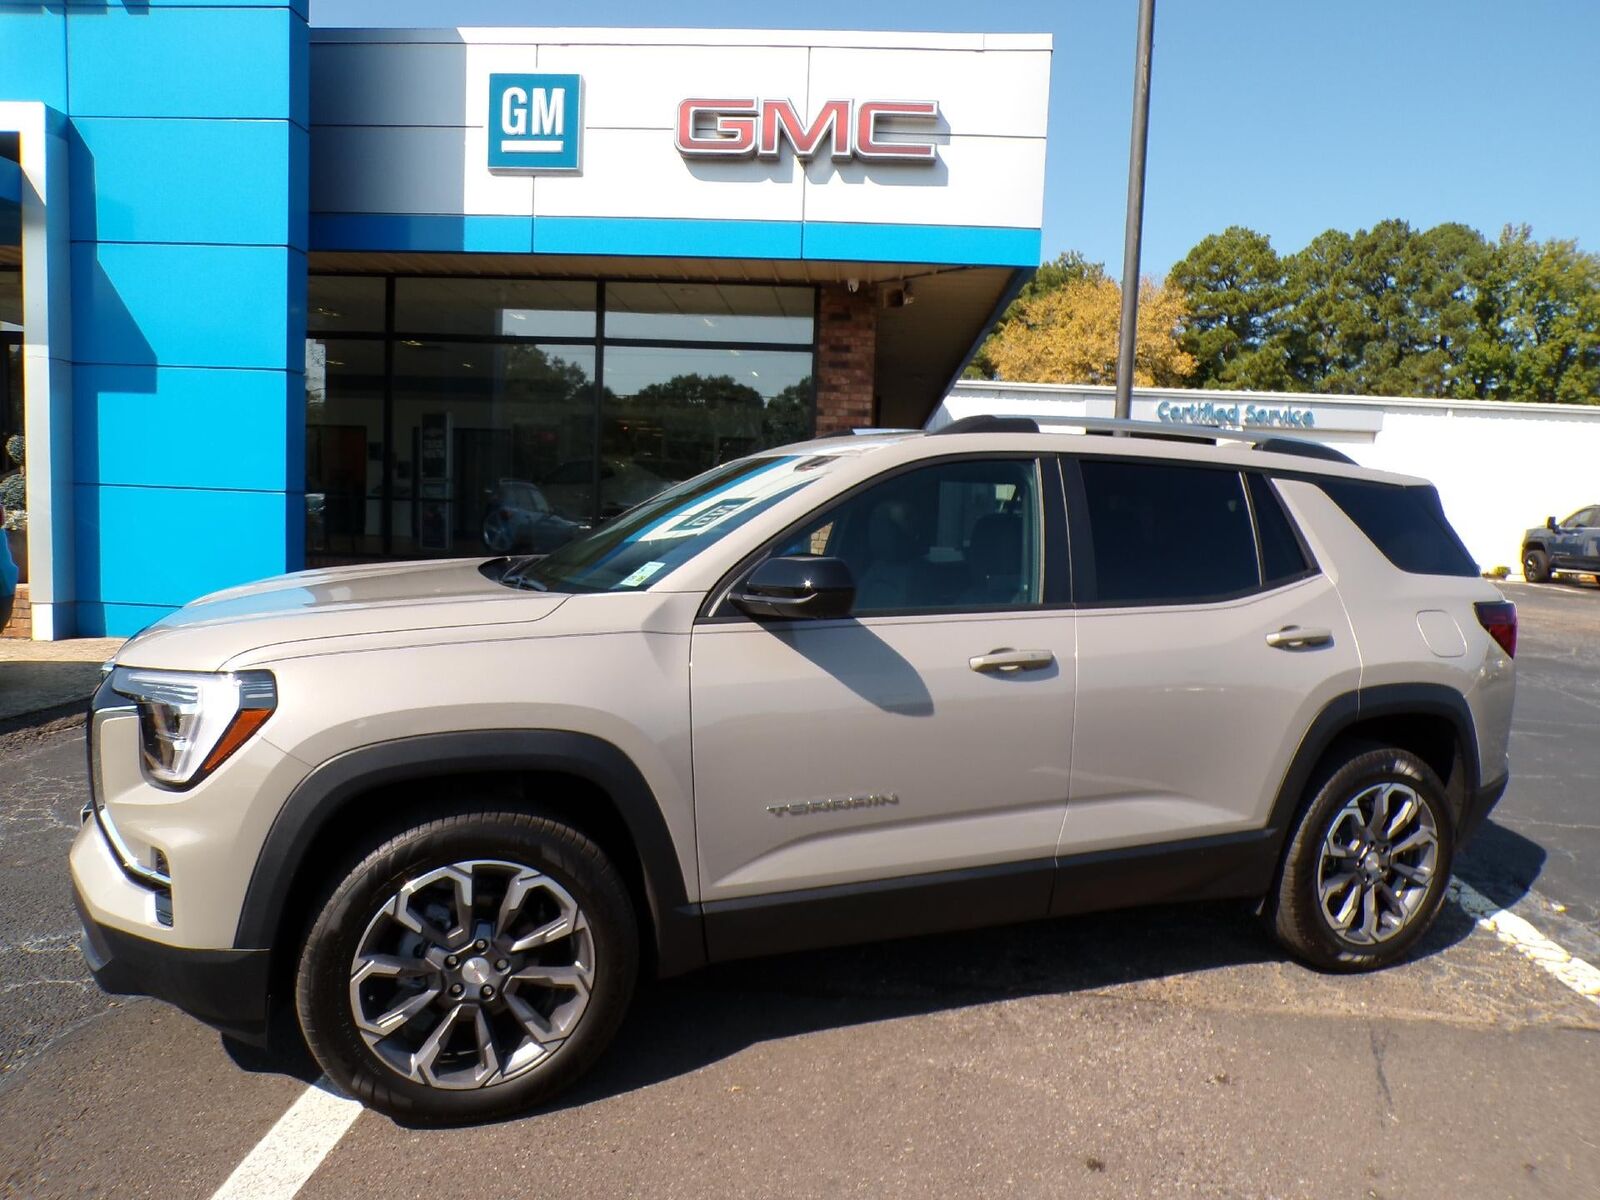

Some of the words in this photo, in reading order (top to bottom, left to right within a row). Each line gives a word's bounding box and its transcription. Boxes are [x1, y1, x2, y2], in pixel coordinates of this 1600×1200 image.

[501, 87, 563, 135] GM
[675, 97, 938, 162] GMC
[1157, 401, 1240, 423] Certified
[1245, 404, 1315, 426] Service
[766, 793, 899, 817] TERRAIN
